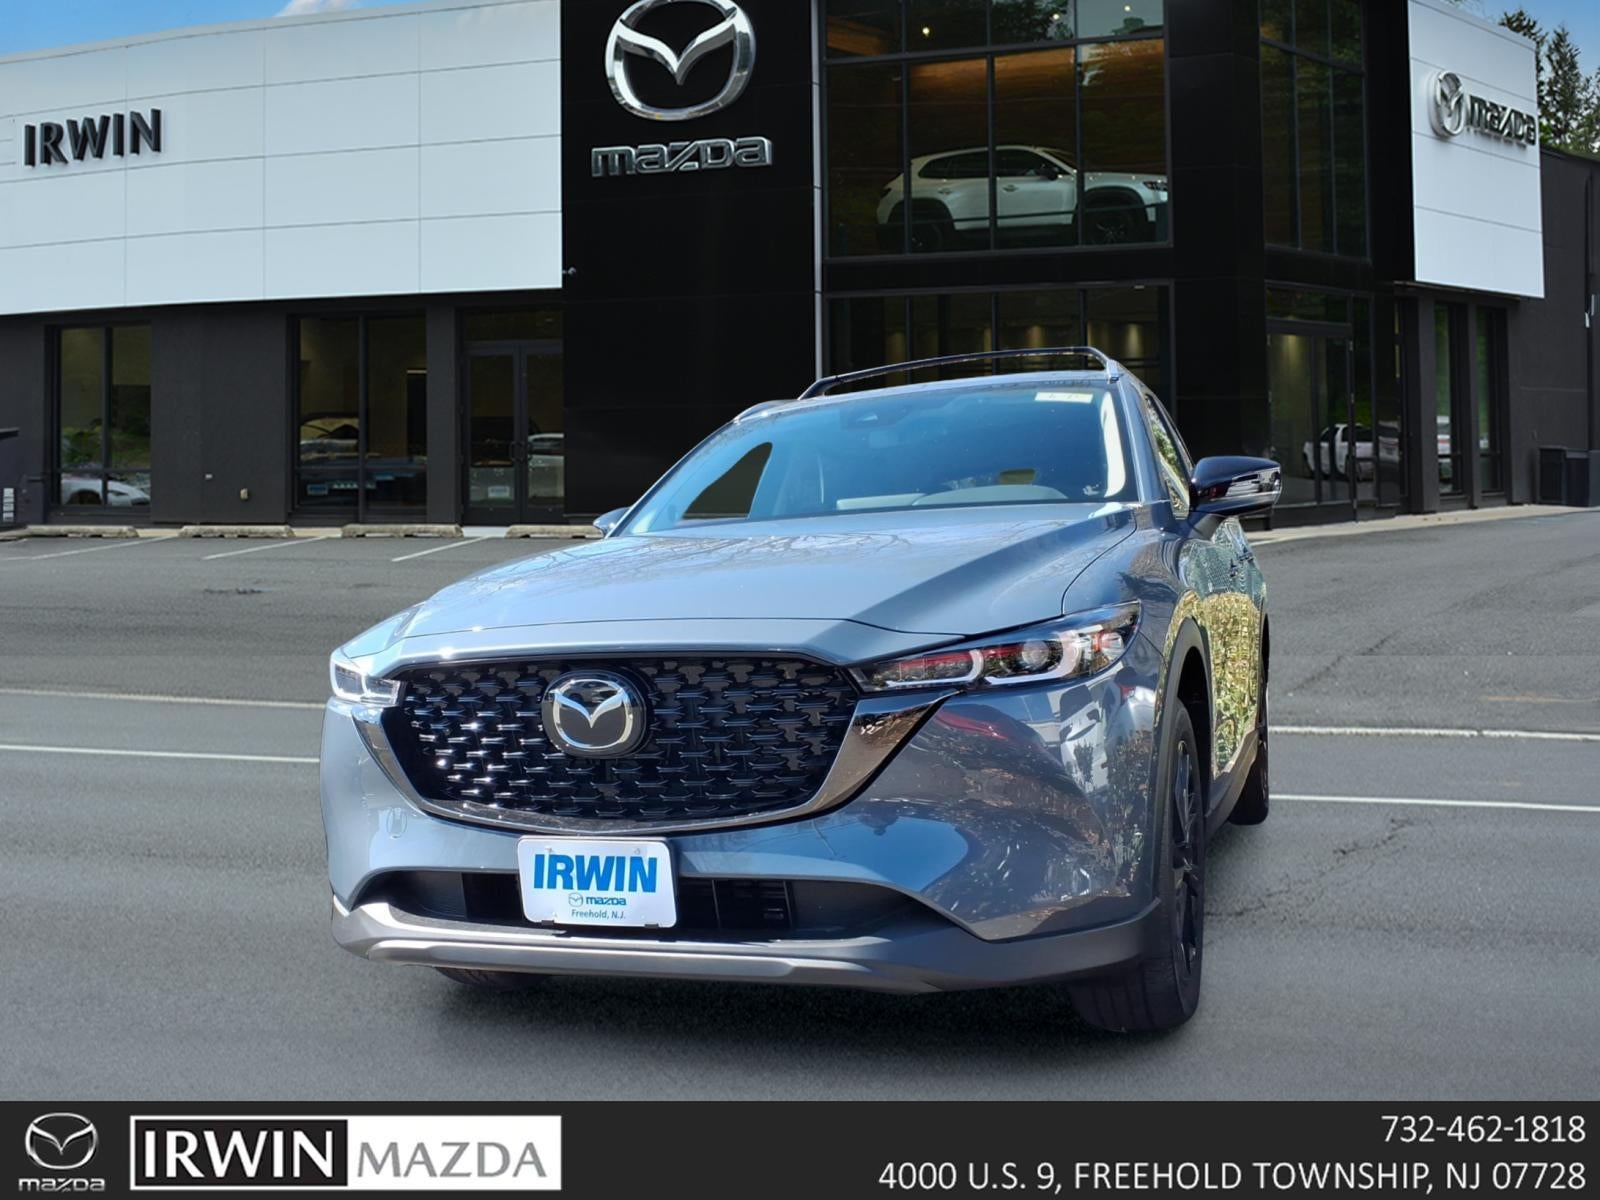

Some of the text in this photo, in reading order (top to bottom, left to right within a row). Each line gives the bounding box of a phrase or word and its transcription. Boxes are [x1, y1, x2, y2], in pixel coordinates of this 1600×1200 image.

[24, 108, 162, 167] IRWIN
[533, 853, 658, 893] IRWIN
[571, 908, 626, 919] Freehold, N.J.
